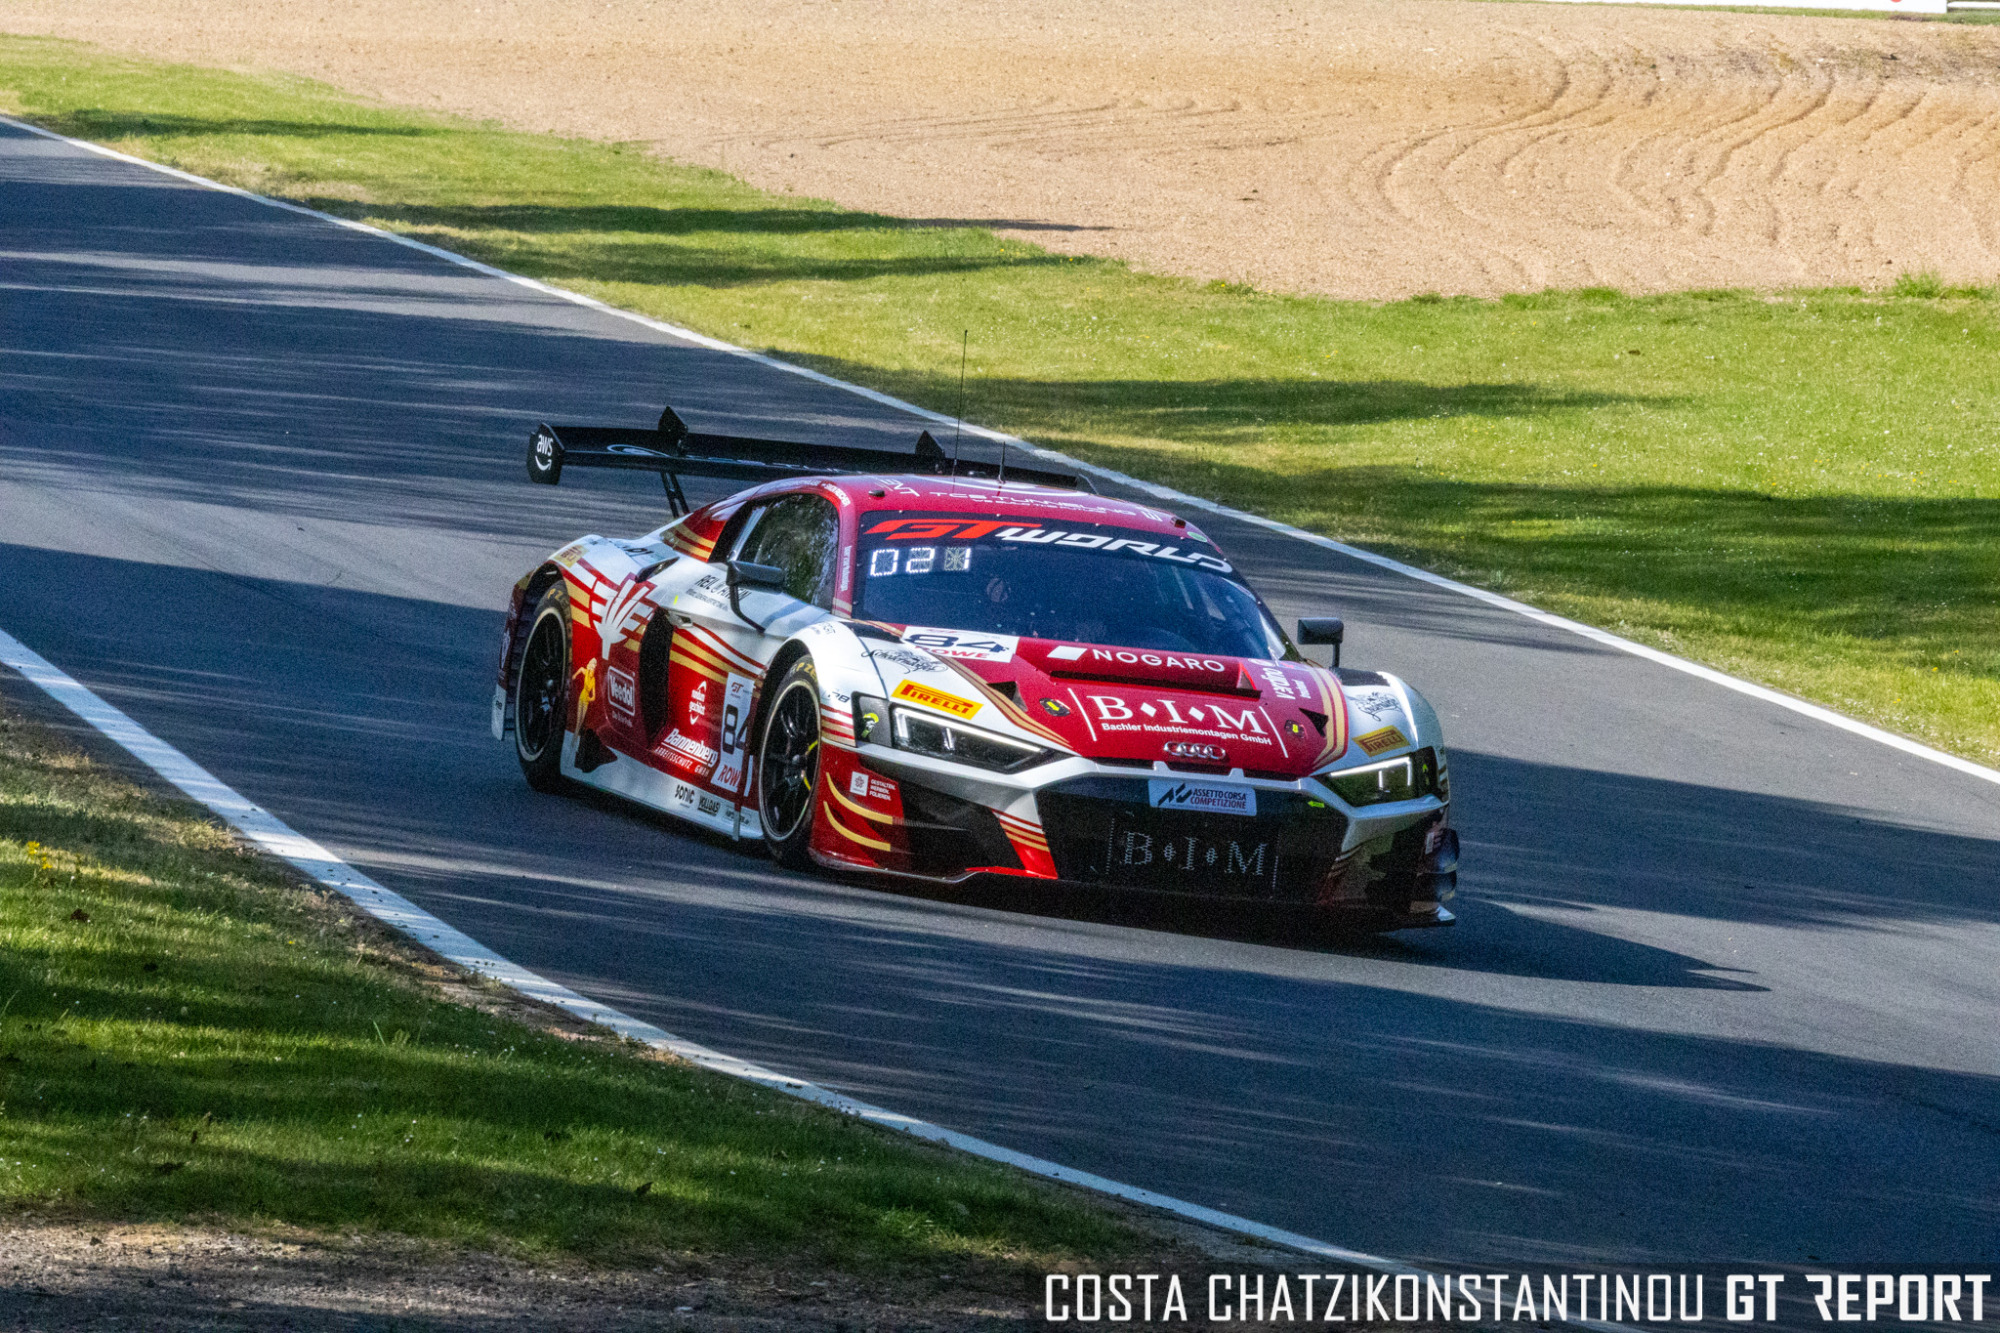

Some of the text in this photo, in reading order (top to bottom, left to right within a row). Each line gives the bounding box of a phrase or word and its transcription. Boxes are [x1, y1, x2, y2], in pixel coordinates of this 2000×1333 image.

[537, 434, 553, 456] aws
[995, 527, 1233, 573] WORLD
[905, 634, 1009, 653] 84
[1093, 649, 1225, 672] NOGARO
[609, 675, 633, 707] Veedol
[900, 683, 973, 715] PIRELLI
[1144, 723, 1239, 740] Industriemontagen
[1240, 733, 1272, 746] GmbH
[1359, 730, 1404, 753] PIRELLI
[654, 746, 694, 770] ARBEITSSCHUTZ
[664, 728, 719, 768] Bannenberg
[1190, 796, 1246, 809] COMPETIZIONE
[1192, 788, 1246, 800] ASSETTO CORSA
